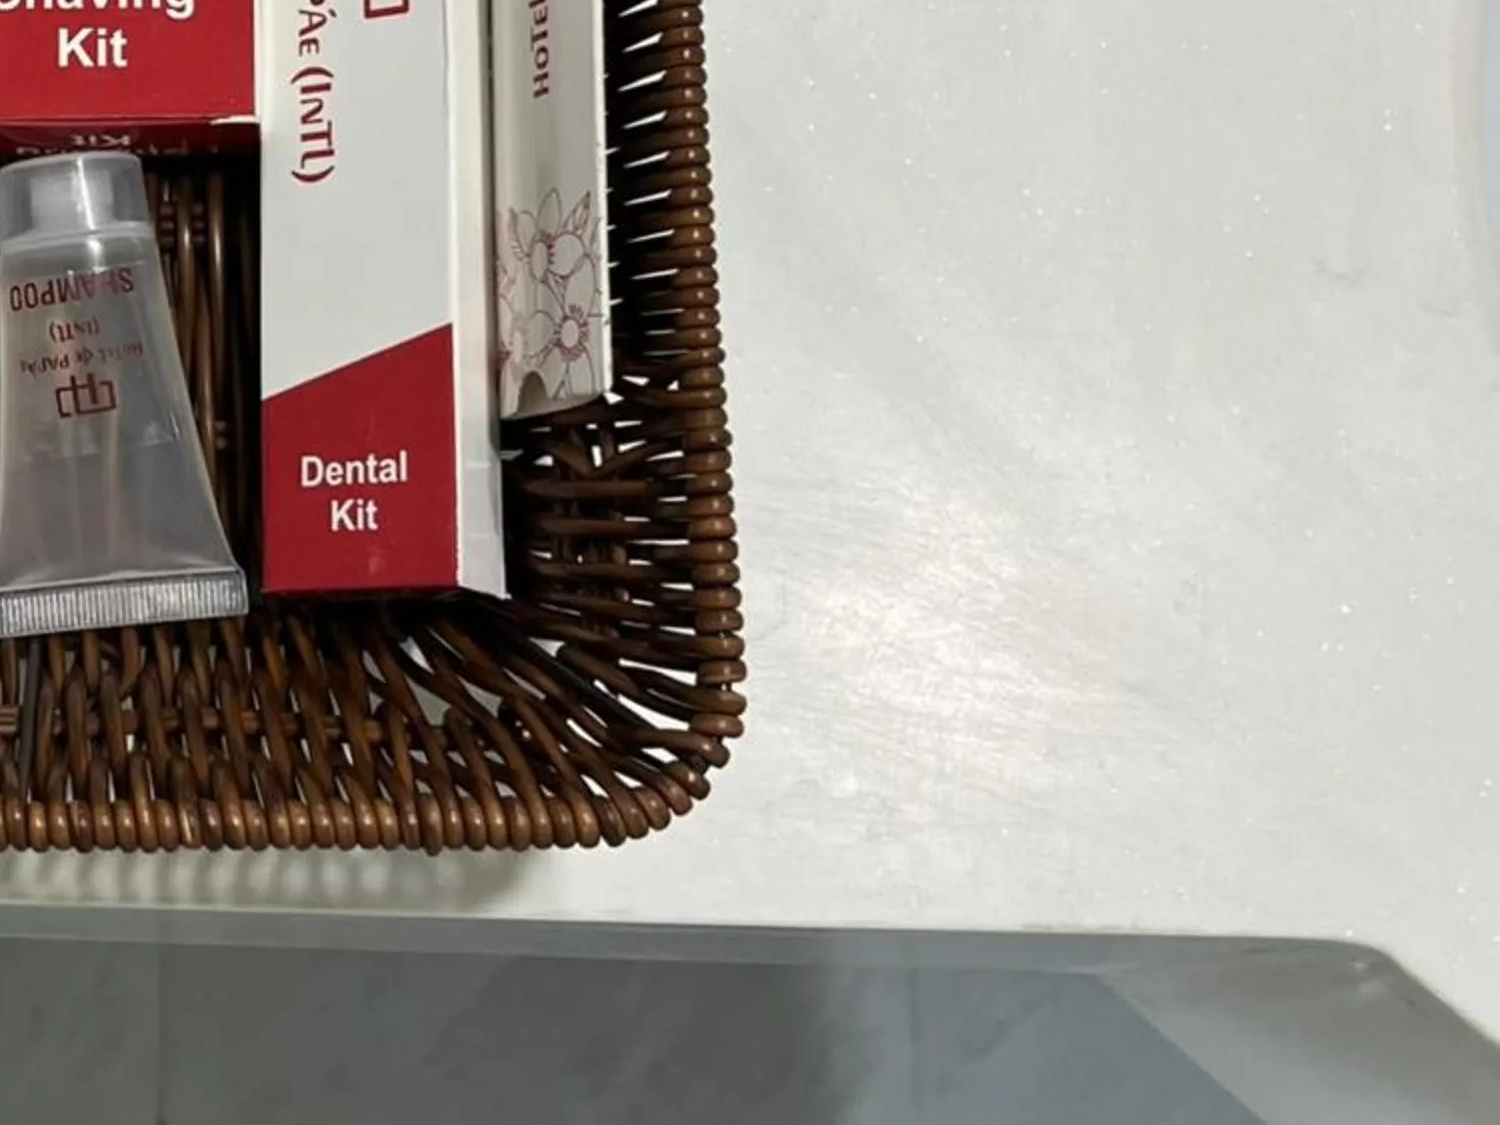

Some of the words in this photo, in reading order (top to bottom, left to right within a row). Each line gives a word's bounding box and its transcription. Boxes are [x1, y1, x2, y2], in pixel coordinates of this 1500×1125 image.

[56, 27, 128, 69] Kit
[9, 266, 135, 313] SHAMPOO
[300, 449, 409, 489] Dental
[330, 498, 379, 533] Kit
